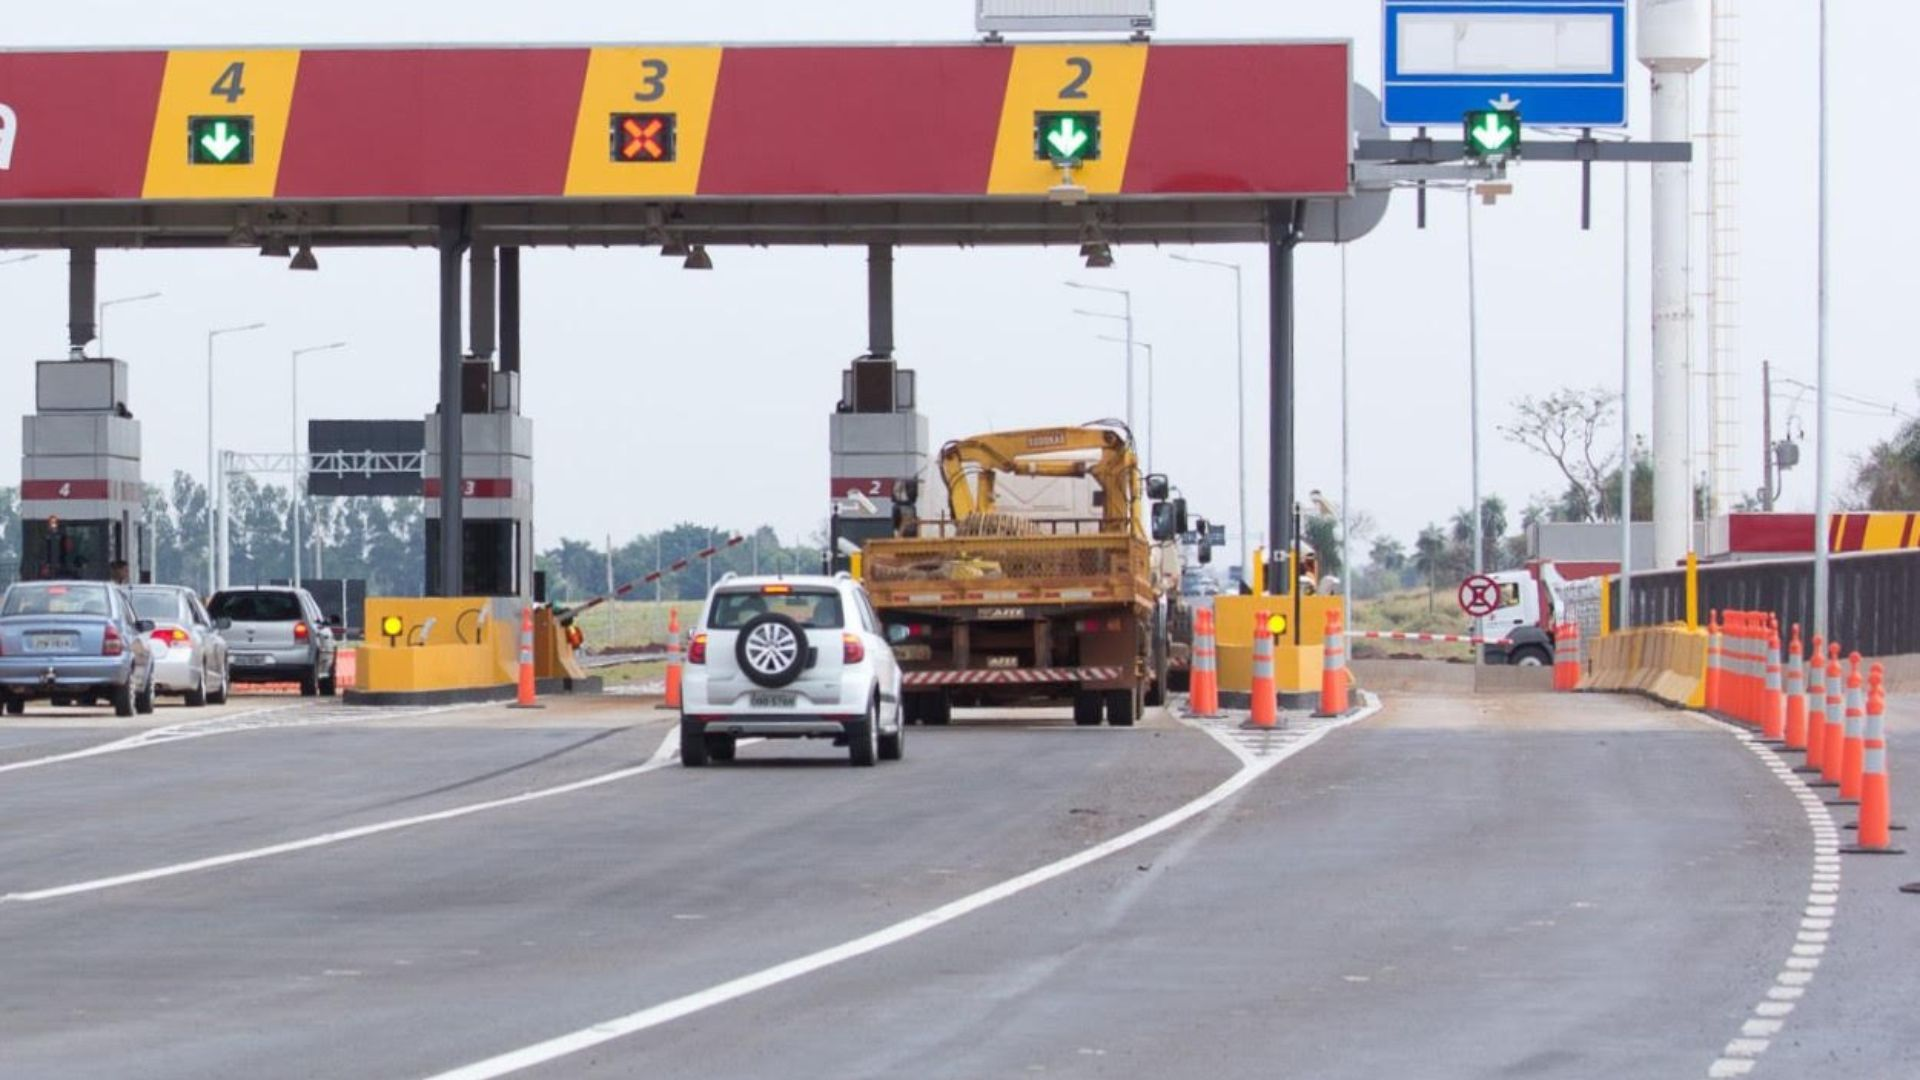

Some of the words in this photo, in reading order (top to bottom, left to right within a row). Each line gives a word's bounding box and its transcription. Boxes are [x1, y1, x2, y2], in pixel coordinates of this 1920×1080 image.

[210, 61, 245, 103] 4
[634, 59, 668, 102] 3
[1058, 57, 1092, 99] 2
[59, 482, 71, 497] 4
[464, 480, 475, 496] 3
[869, 480, 881, 494] 2
